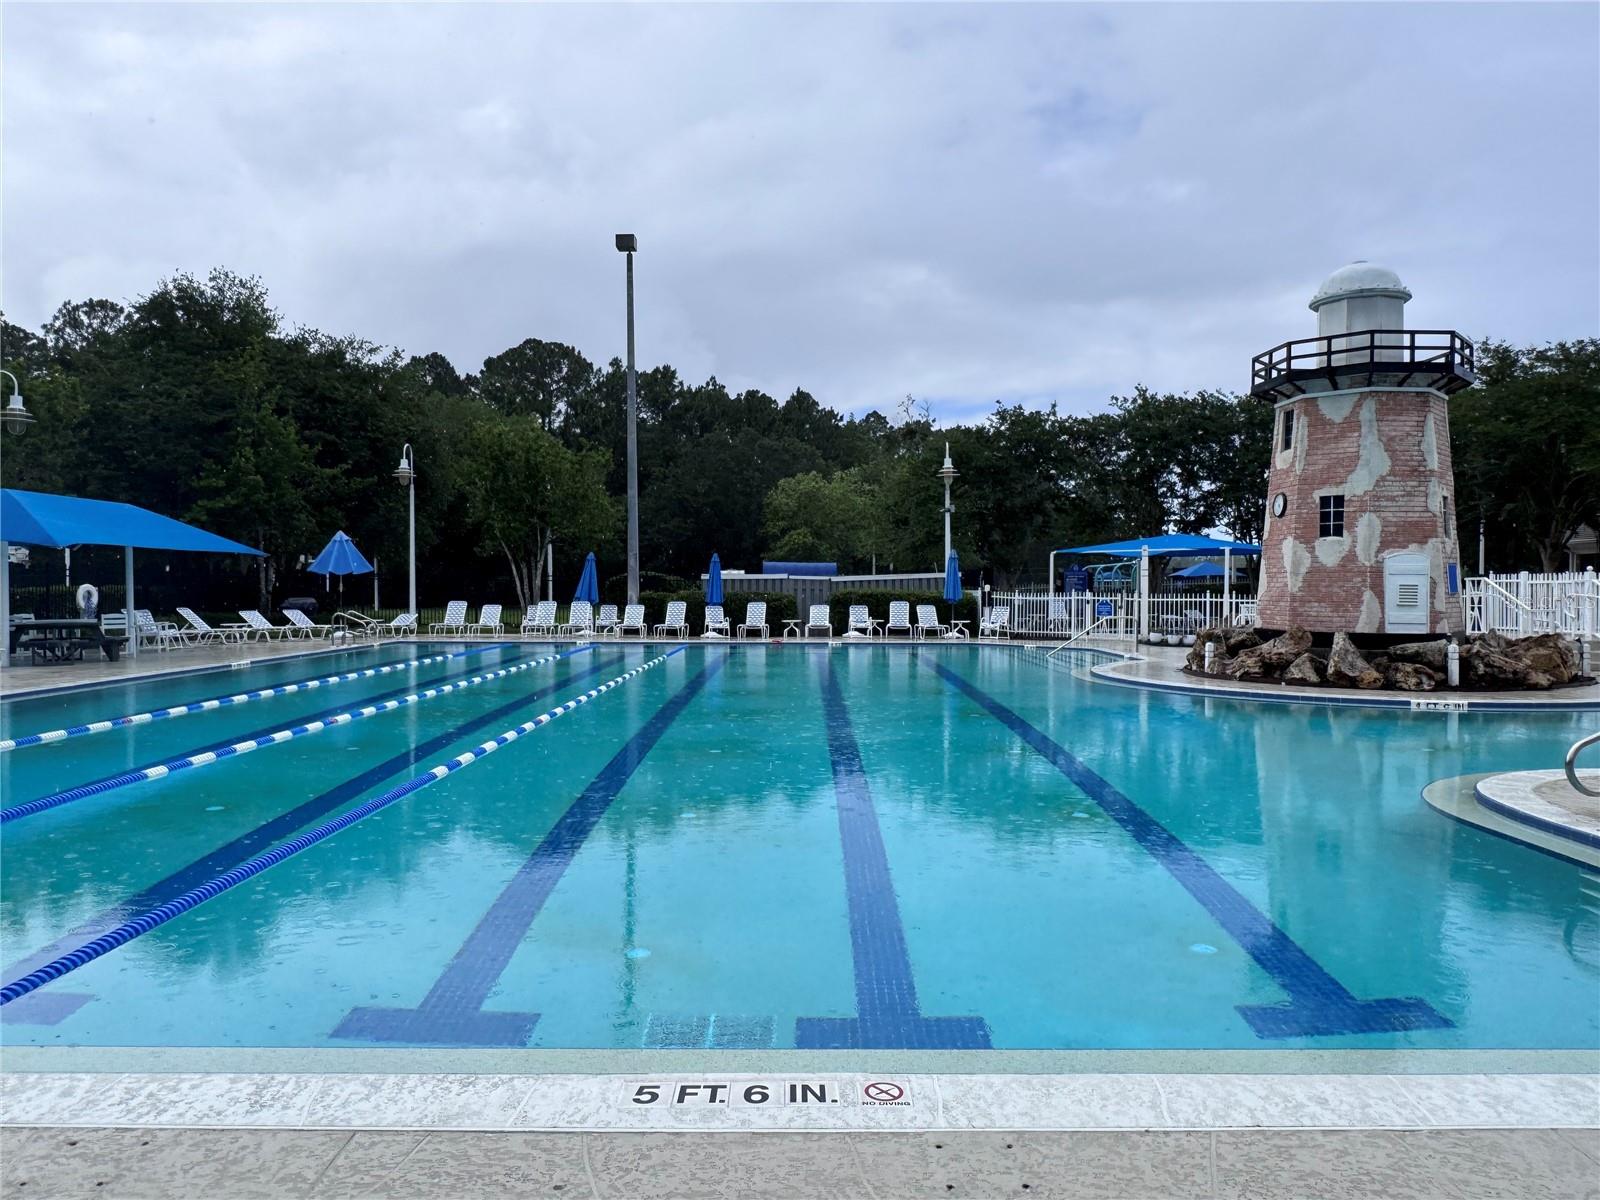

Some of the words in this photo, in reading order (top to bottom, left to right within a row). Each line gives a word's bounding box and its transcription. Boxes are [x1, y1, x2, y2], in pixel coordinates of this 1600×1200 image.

[632, 1085, 660, 1104] 5
[677, 1085, 727, 1103] FT.
[743, 1085, 769, 1104] 6
[789, 1084, 838, 1103] IN.
